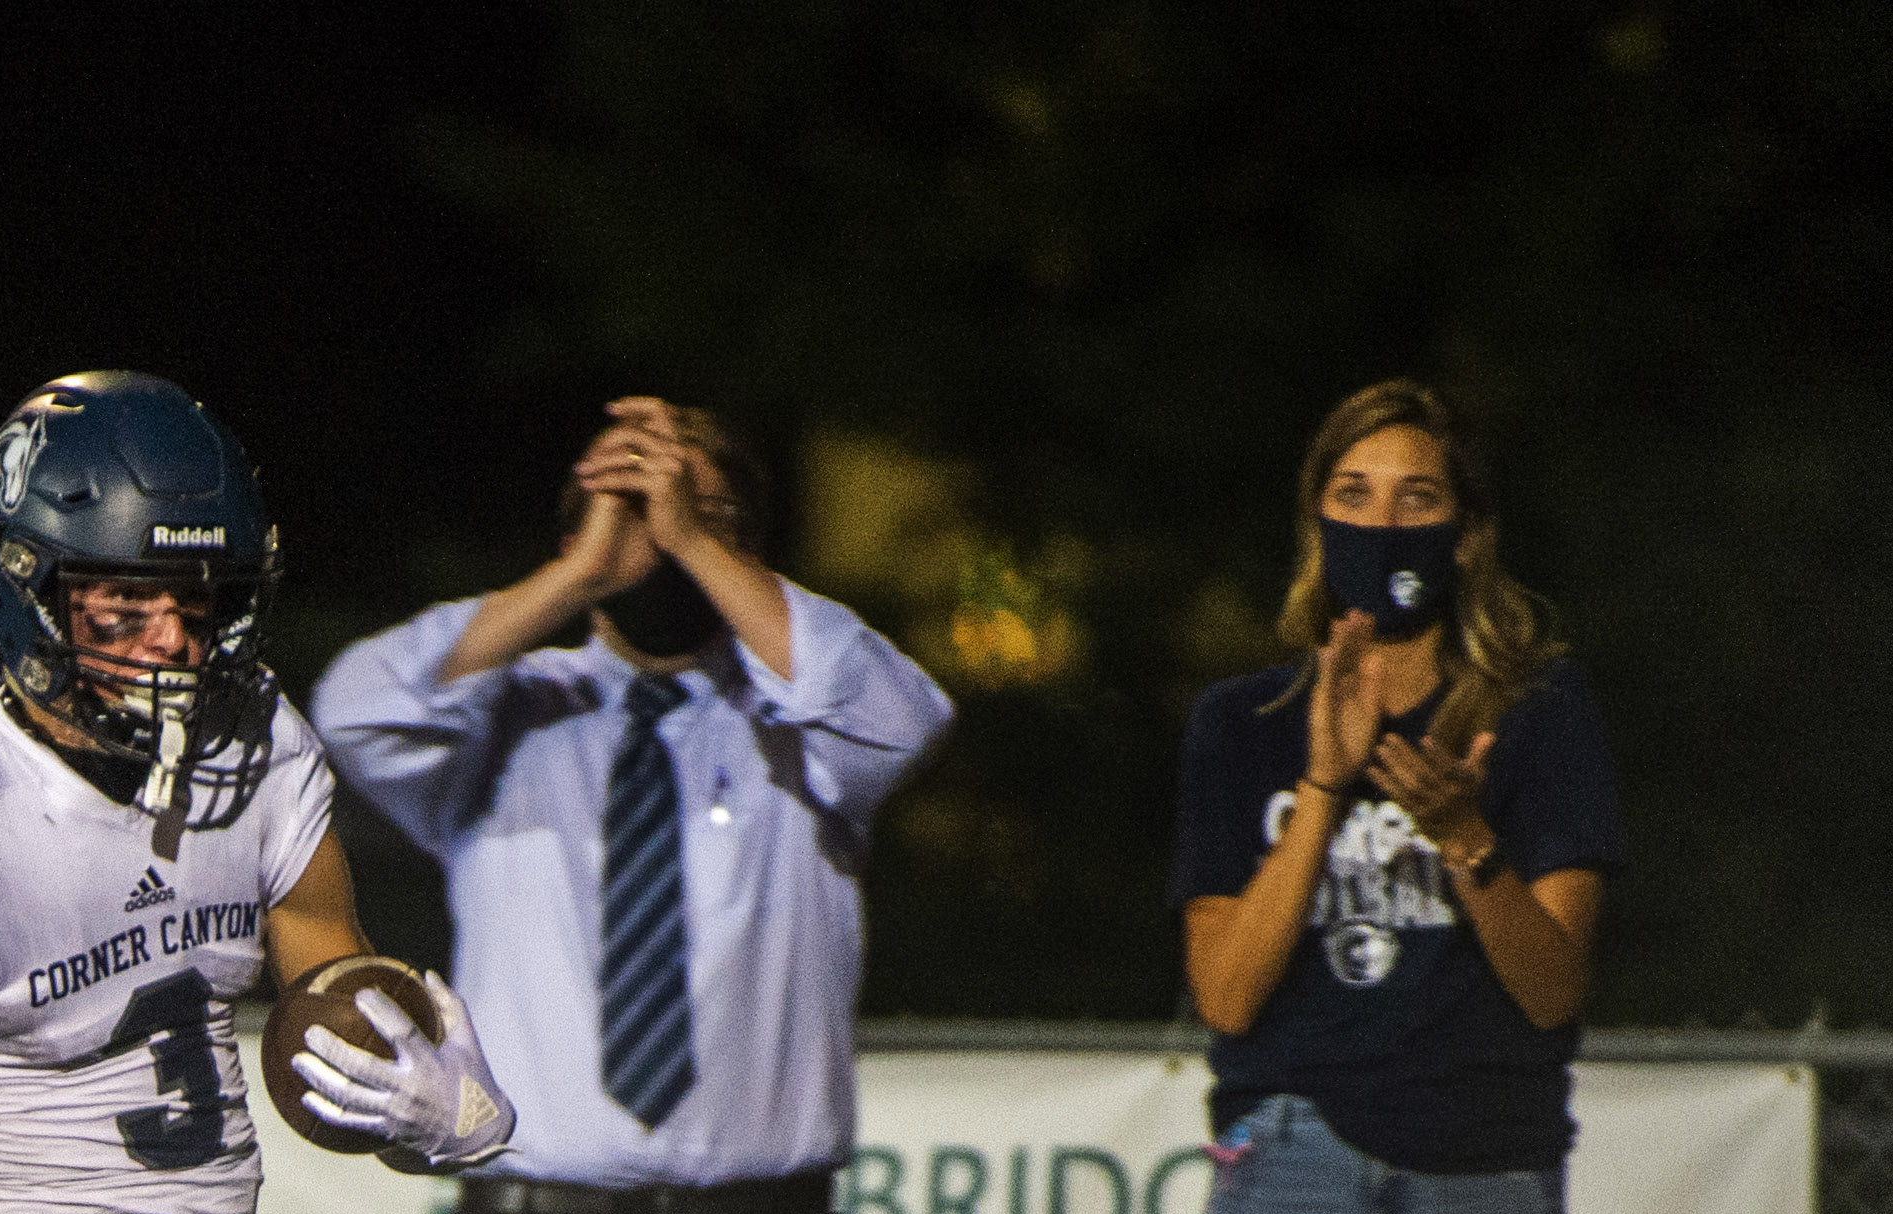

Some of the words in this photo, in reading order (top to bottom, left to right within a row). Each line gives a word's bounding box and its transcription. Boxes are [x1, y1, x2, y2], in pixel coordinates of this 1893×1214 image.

[152, 525, 226, 548] Riddell
[124, 886, 176, 913] adidas
[28, 924, 151, 1008] CORNER
[160, 901, 259, 955] CANYON
[108, 966, 225, 1171] 3
